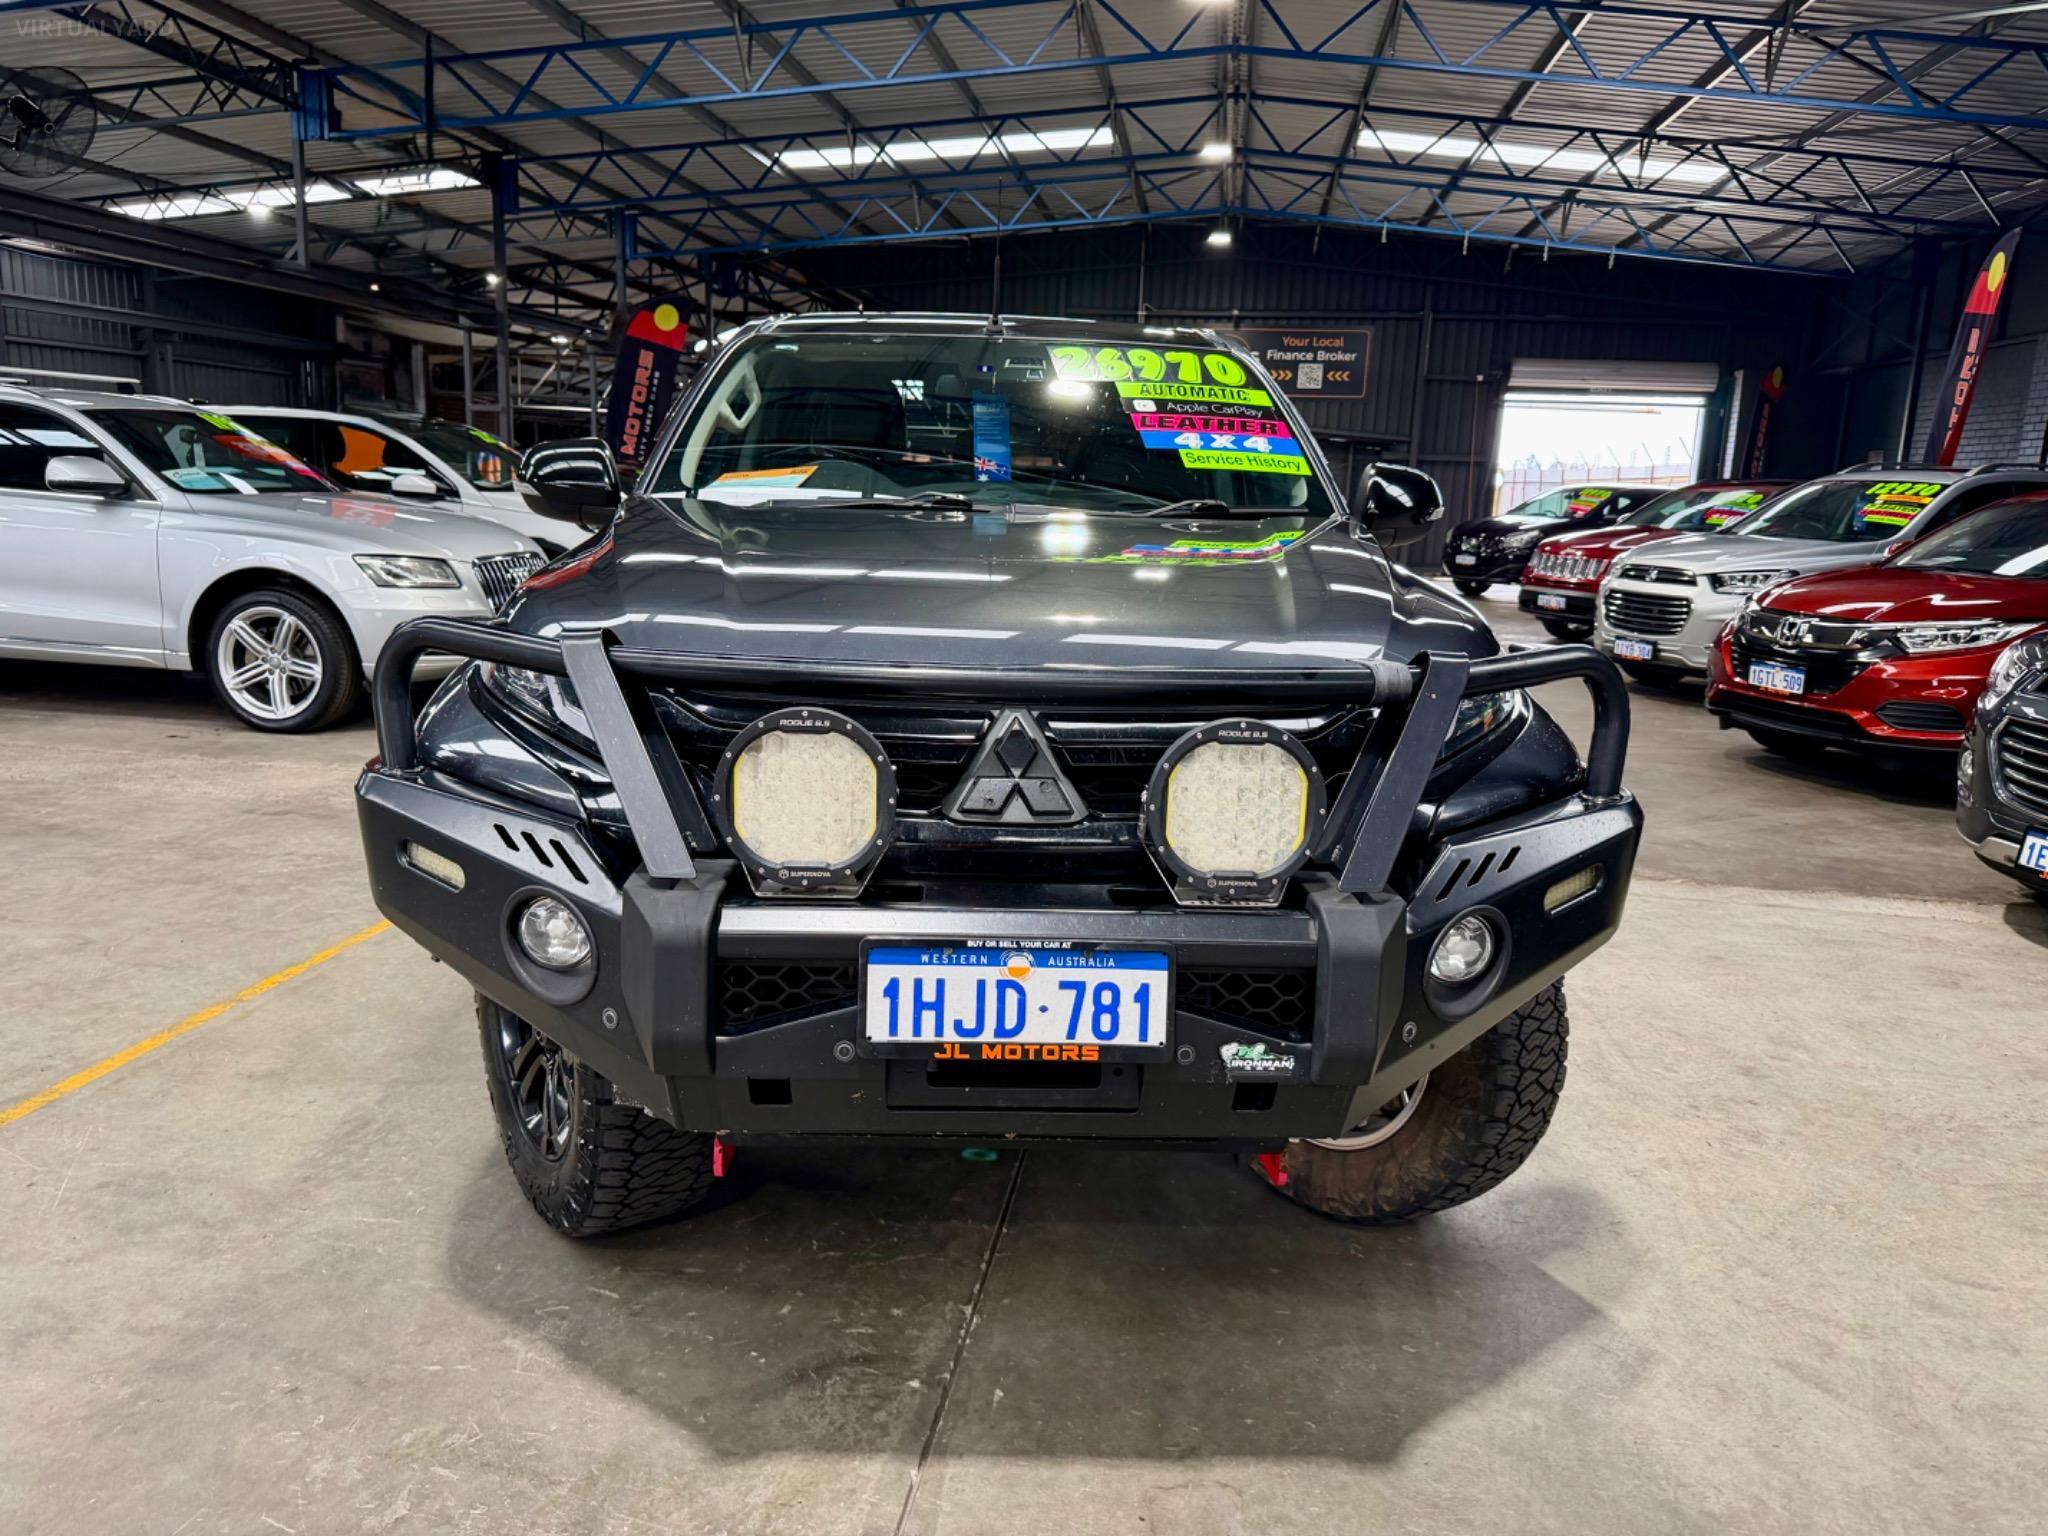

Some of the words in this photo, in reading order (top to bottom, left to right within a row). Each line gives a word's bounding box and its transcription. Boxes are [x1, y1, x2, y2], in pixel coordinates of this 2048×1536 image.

[1282, 336, 1309, 347] Your
[1313, 336, 1345, 347] Local
[1266, 349, 1314, 361] Finance
[1317, 350, 1358, 362] Broker
[1053, 346, 1246, 386] 26970
[1140, 383, 1250, 402] AUTOMATIC
[620, 349, 654, 455] MOTORS
[1167, 401, 1209, 414] Apple
[1211, 403, 1263, 419] CarPlay
[1139, 414, 1279, 434] LEATHER
[1185, 451, 1244, 466] Service
[1248, 455, 1301, 472] History
[967, 940, 983, 948] BUY
[984, 940, 997, 948] OR
[1019, 941, 1042, 949] YOUR
[1043, 941, 1061, 949] CAR
[1061, 941, 1072, 949] AT
[920, 953, 988, 965] WESTERN
[1048, 956, 1116, 968] AUSTRALIA
[934, 1044, 970, 1060] JL
[982, 1043, 1100, 1061] MOTORS
[1231, 1059, 1290, 1069] IRONMAN
